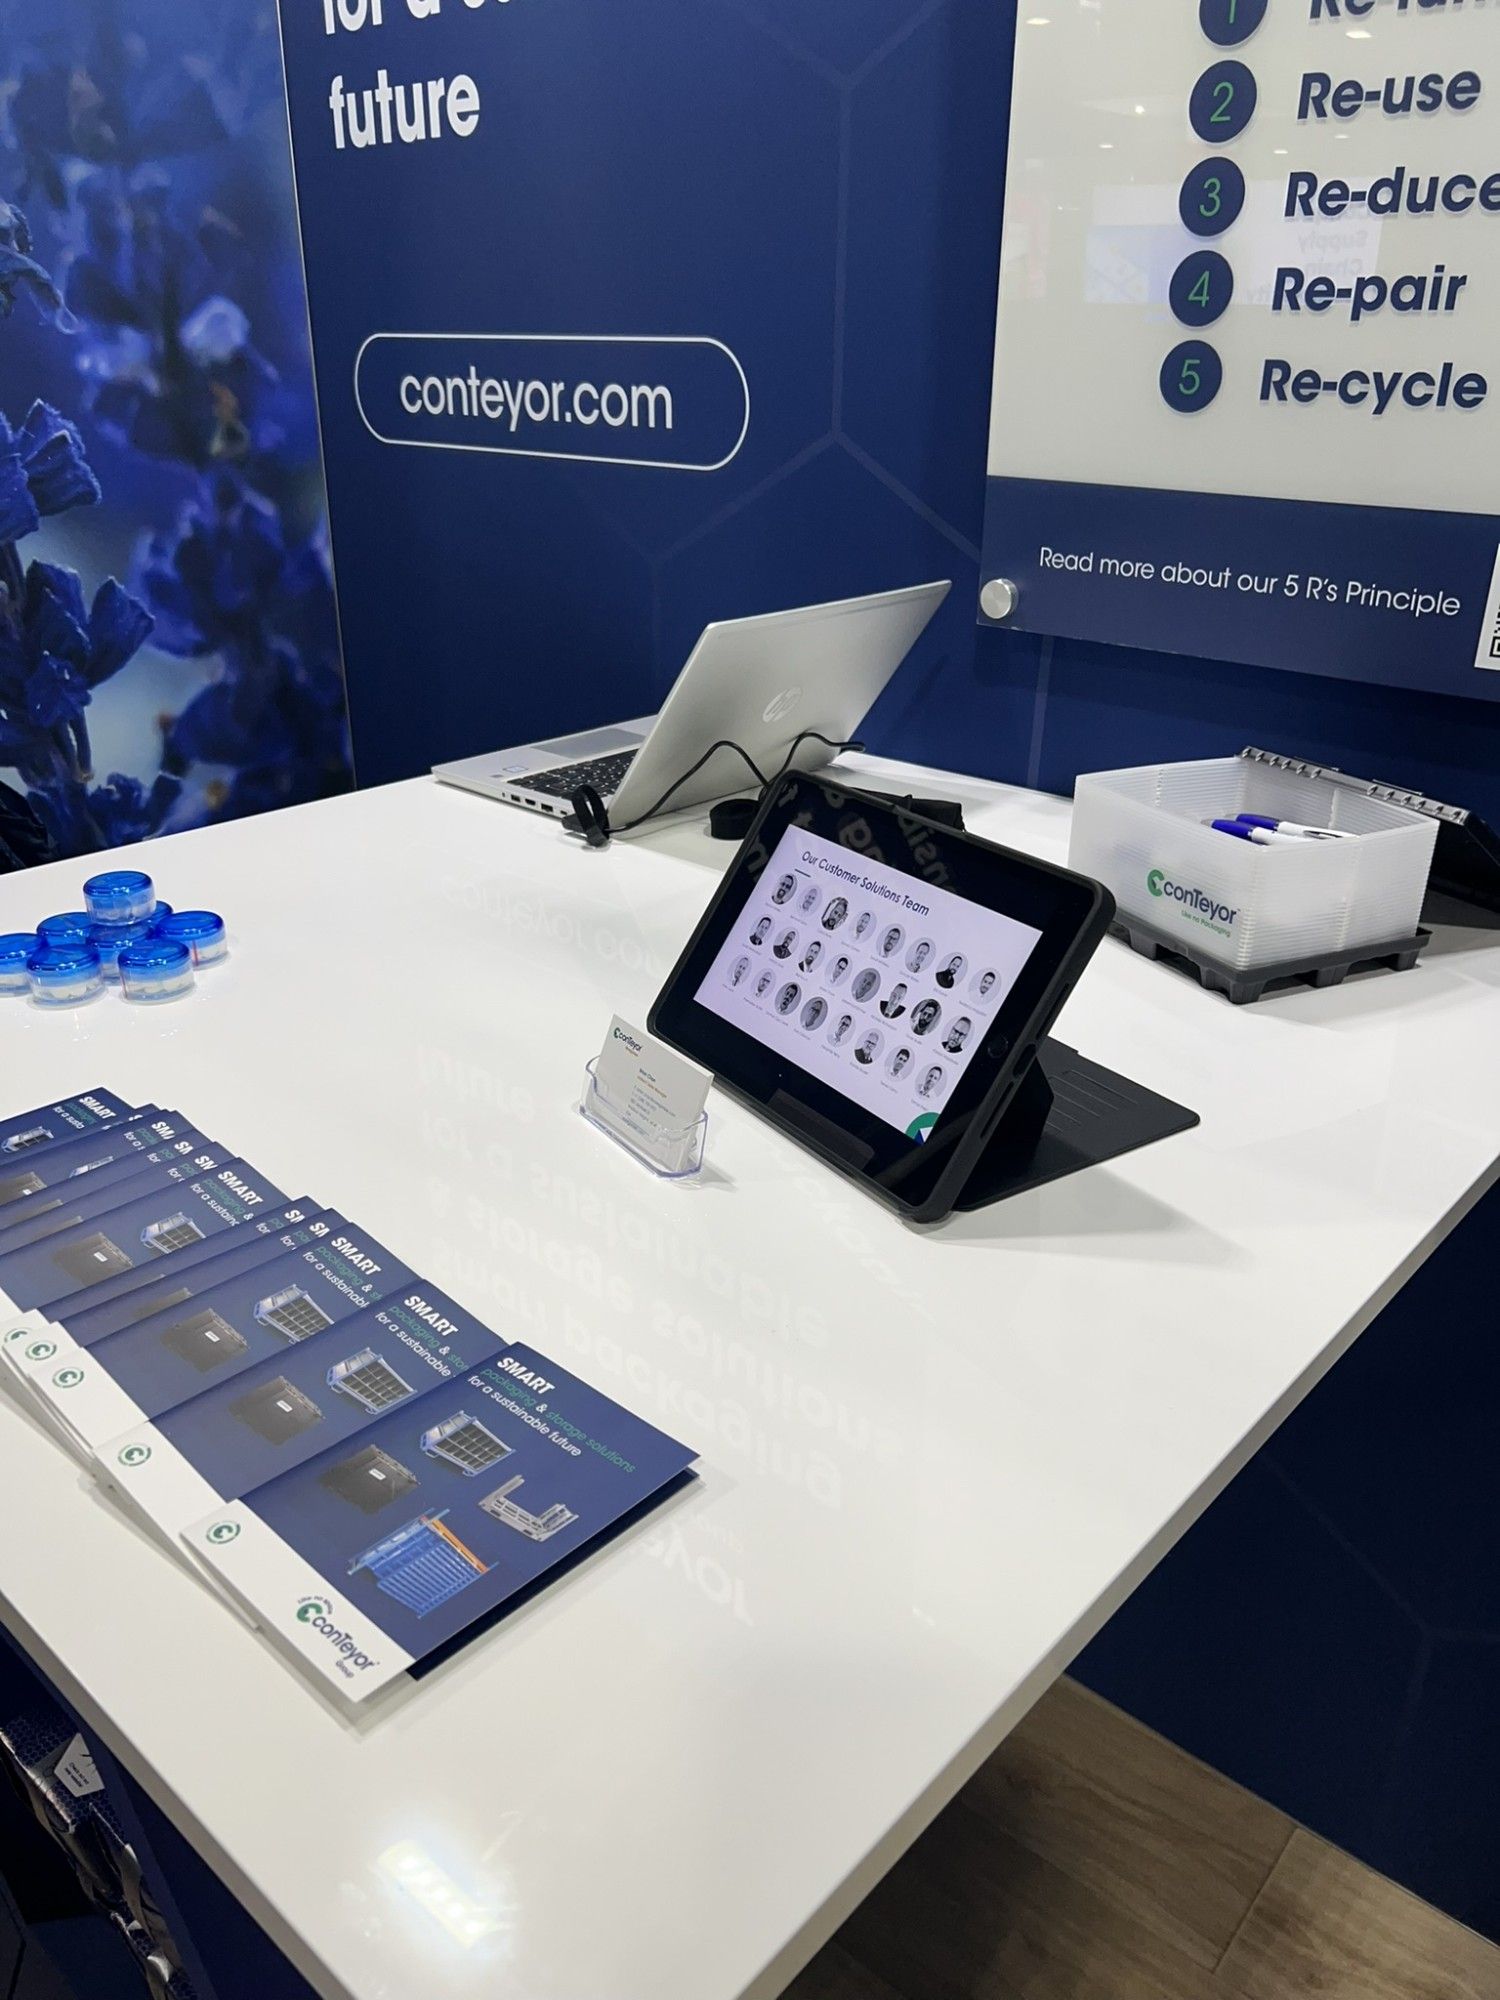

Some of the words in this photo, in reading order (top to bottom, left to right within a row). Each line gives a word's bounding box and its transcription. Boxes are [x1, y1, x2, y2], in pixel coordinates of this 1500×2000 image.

[328, 69, 481, 149] future
[1209, 81, 1234, 122] 2
[1297, 71, 1481, 120] Re-use
[1200, 177, 1221, 217] 3
[1187, 270, 1211, 308] 4
[1272, 265, 1468, 322] Re-pair
[1178, 359, 1201, 395] 5
[1259, 358, 1488, 415] Re-cycle
[400, 365, 673, 432] conteyor.com
[1039, 547, 1094, 572] Read
[1099, 558, 1155, 579] more
[1161, 563, 1232, 588] about
[1237, 572, 1278, 594] our
[1283, 574, 1300, 597] 5
[1345, 581, 1461, 617] Principle
[802, 851, 818, 865] Our
[818, 858, 861, 885] Customer
[860, 877, 901, 904] Solutions
[901, 895, 930, 917] Team
[79, 1096, 117, 1119] SMART
[190, 1183, 205, 1194] for
[218, 1171, 263, 1205] SMART
[256, 1223, 271, 1234] for
[280, 1235, 295, 1248] for
[302, 1251, 318, 1263] for
[315, 1262, 325, 1270] a
[315, 1246, 364, 1286] packaging
[361, 1284, 373, 1293] &
[331, 1237, 381, 1275] SMART
[387, 1306, 441, 1349] packaging
[438, 1346, 451, 1356] &
[404, 1295, 459, 1336] SMART
[375, 1312, 391, 1325] for
[388, 1324, 399, 1332] a
[397, 1330, 451, 1377] sustainable
[497, 1357, 555, 1395] SMART
[467, 1375, 483, 1389] for
[482, 1384, 493, 1394] a
[491, 1391, 551, 1436] sustainable
[548, 1431, 582, 1457] future
[480, 1368, 537, 1408] packaging
[535, 1403, 548, 1413] &
[545, 1410, 587, 1441] storage
[585, 1438, 636, 1473] solutions
